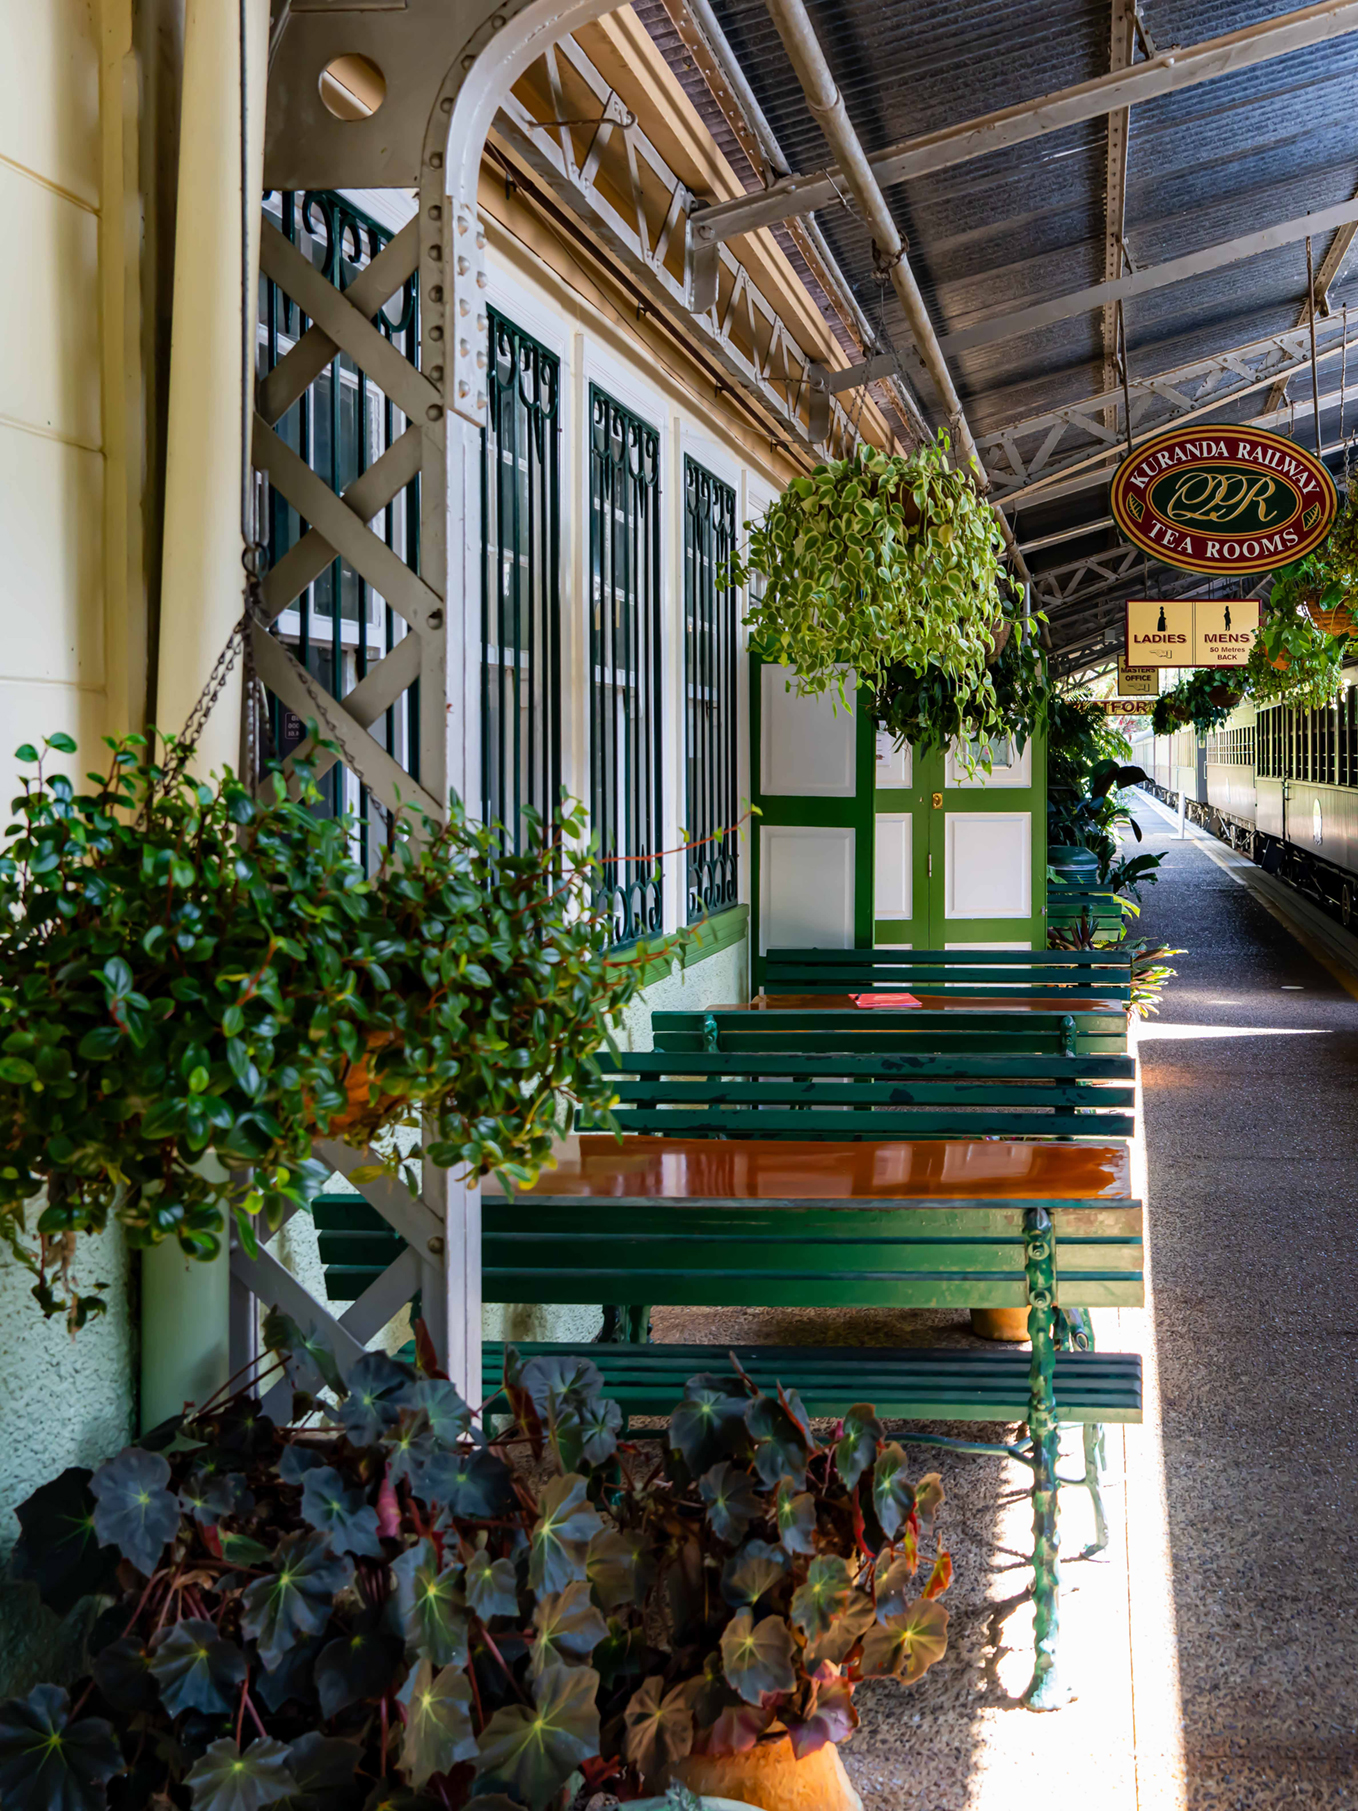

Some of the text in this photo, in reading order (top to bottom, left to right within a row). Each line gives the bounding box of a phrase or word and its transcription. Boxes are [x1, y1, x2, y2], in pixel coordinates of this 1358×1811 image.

[1129, 440, 1321, 494] KURANDA RAILWAY
[1148, 520, 1299, 559] TEA ROOMS
[1133, 633, 1187, 644] LADIES
[1204, 633, 1250, 644] MENS
[1125, 674, 1152, 682] OFFICE
